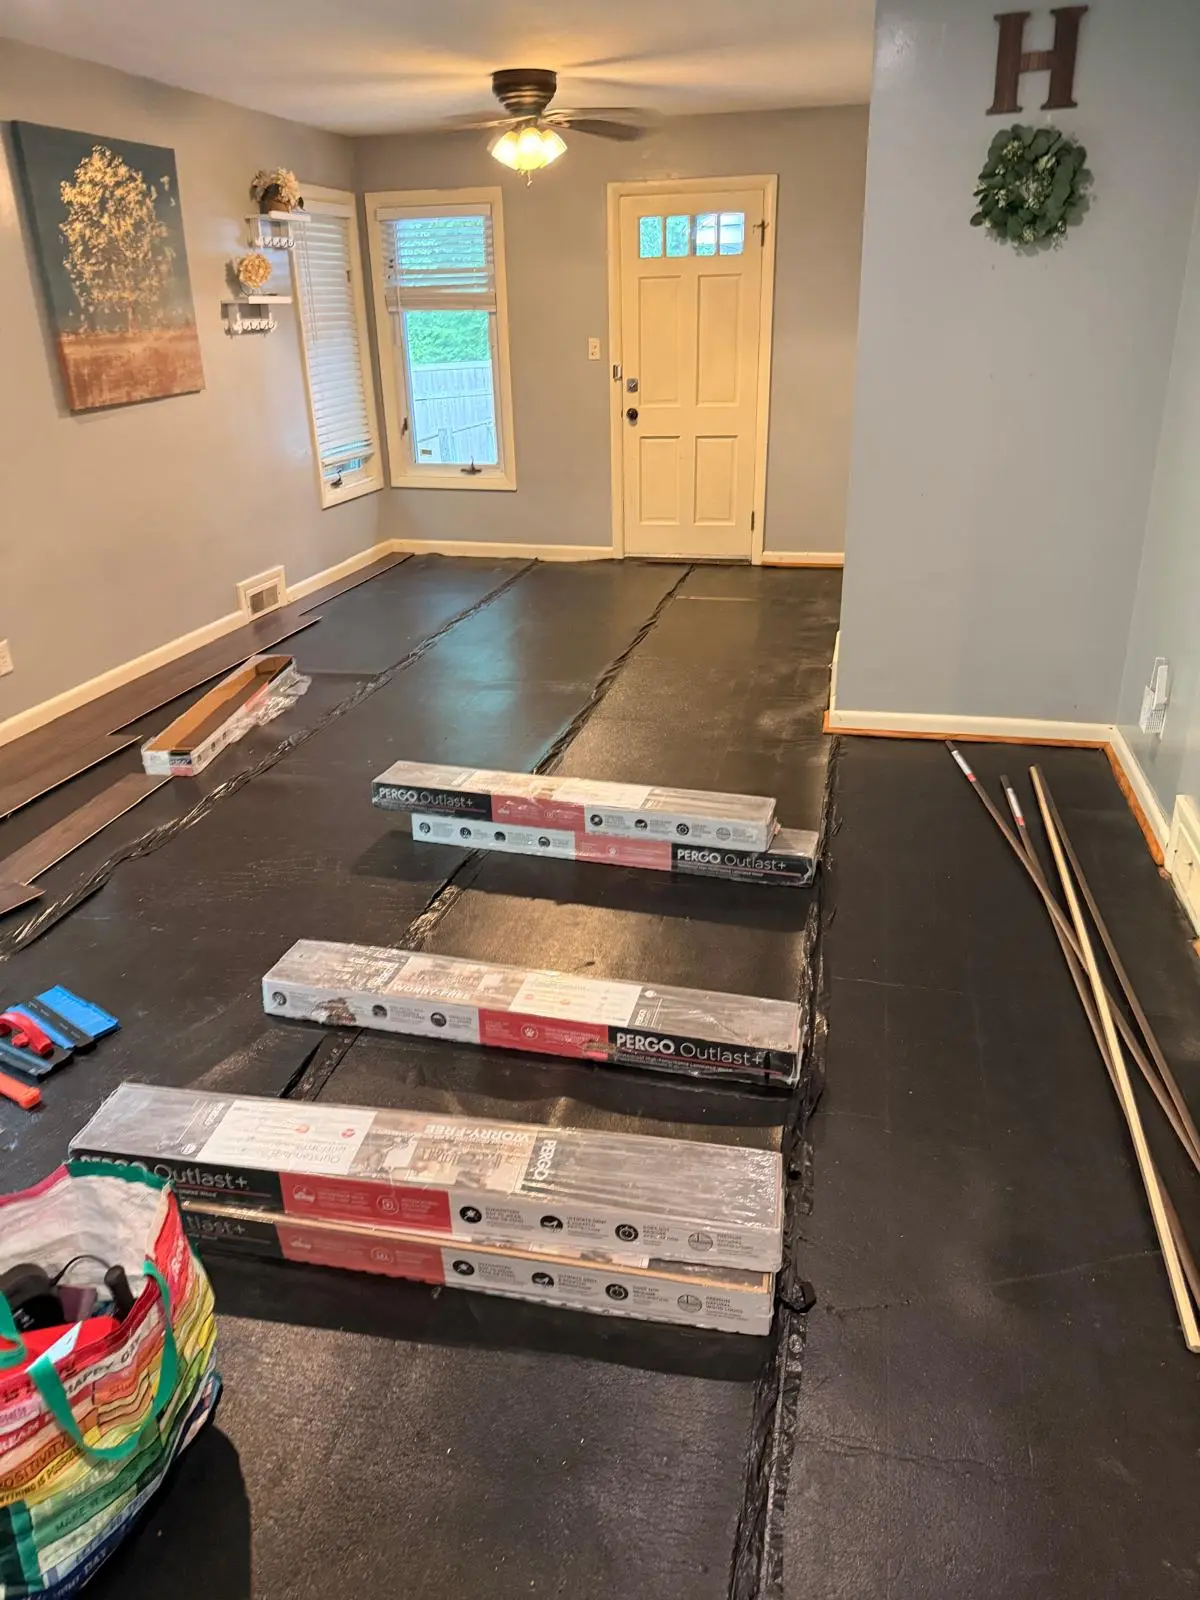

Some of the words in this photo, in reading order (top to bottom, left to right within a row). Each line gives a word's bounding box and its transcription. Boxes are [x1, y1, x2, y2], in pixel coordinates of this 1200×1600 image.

[986, 5, 1088, 115] H
[379, 787, 417, 803] PERGO
[419, 791, 473, 808] Outlast+
[677, 848, 721, 864] PERGO
[724, 854, 787, 871] Outlast+
[616, 1032, 676, 1055] PERGO
[680, 1042, 764, 1066] Outlast+
[532, 1139, 558, 1181] PERGO
[153, 1164, 248, 1189] Outlast+
[186, 1215, 246, 1236] tlast+
[0, 1435, 67, 1488] OSITIVITY
